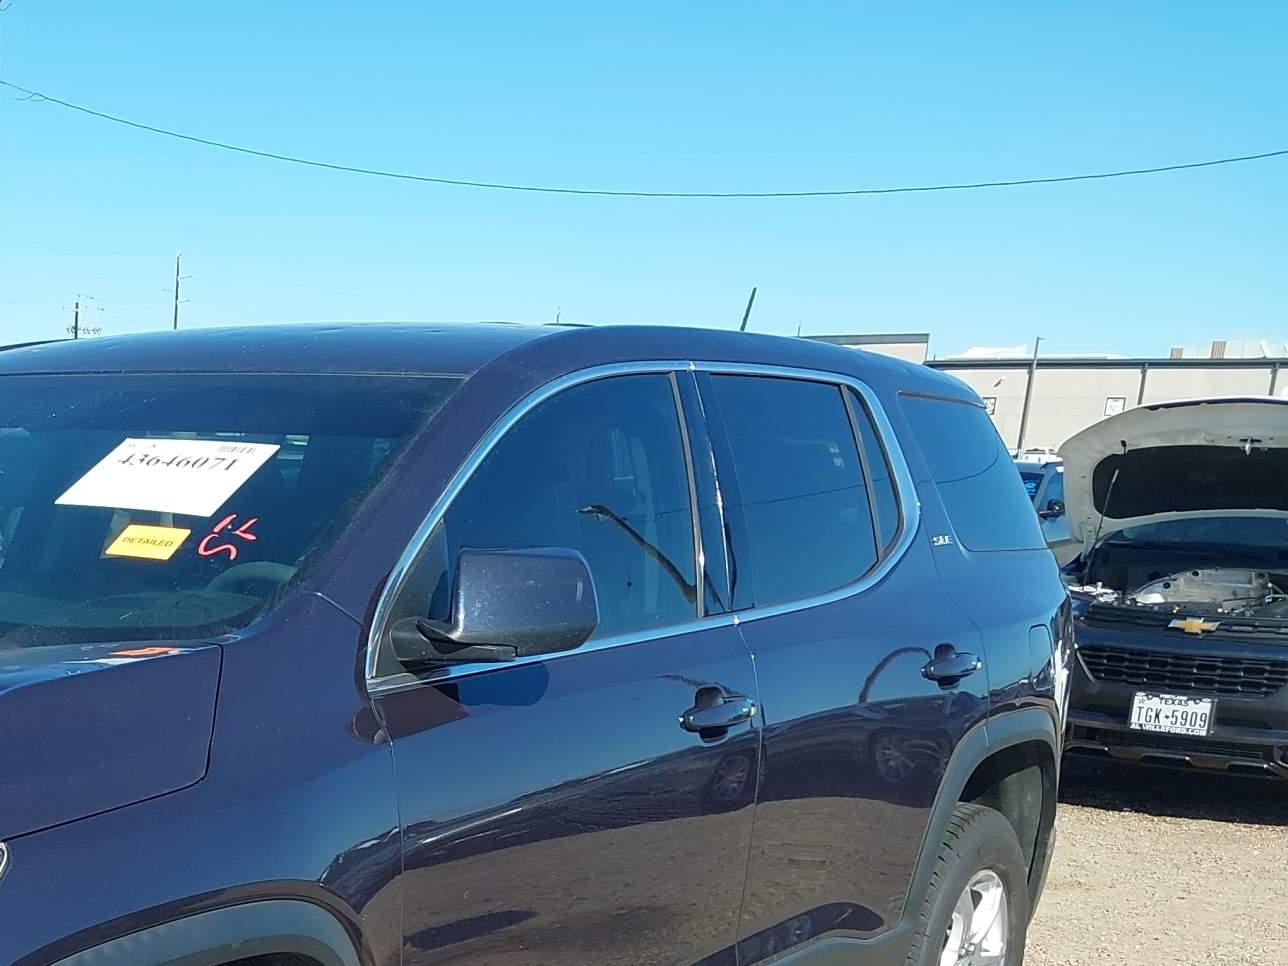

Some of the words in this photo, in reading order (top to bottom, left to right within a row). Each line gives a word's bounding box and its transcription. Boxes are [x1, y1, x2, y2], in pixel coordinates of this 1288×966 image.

[117, 453, 239, 471] 43646071
[123, 536, 174, 547] DETAILED
[1160, 699, 1189, 707] TEXAS
